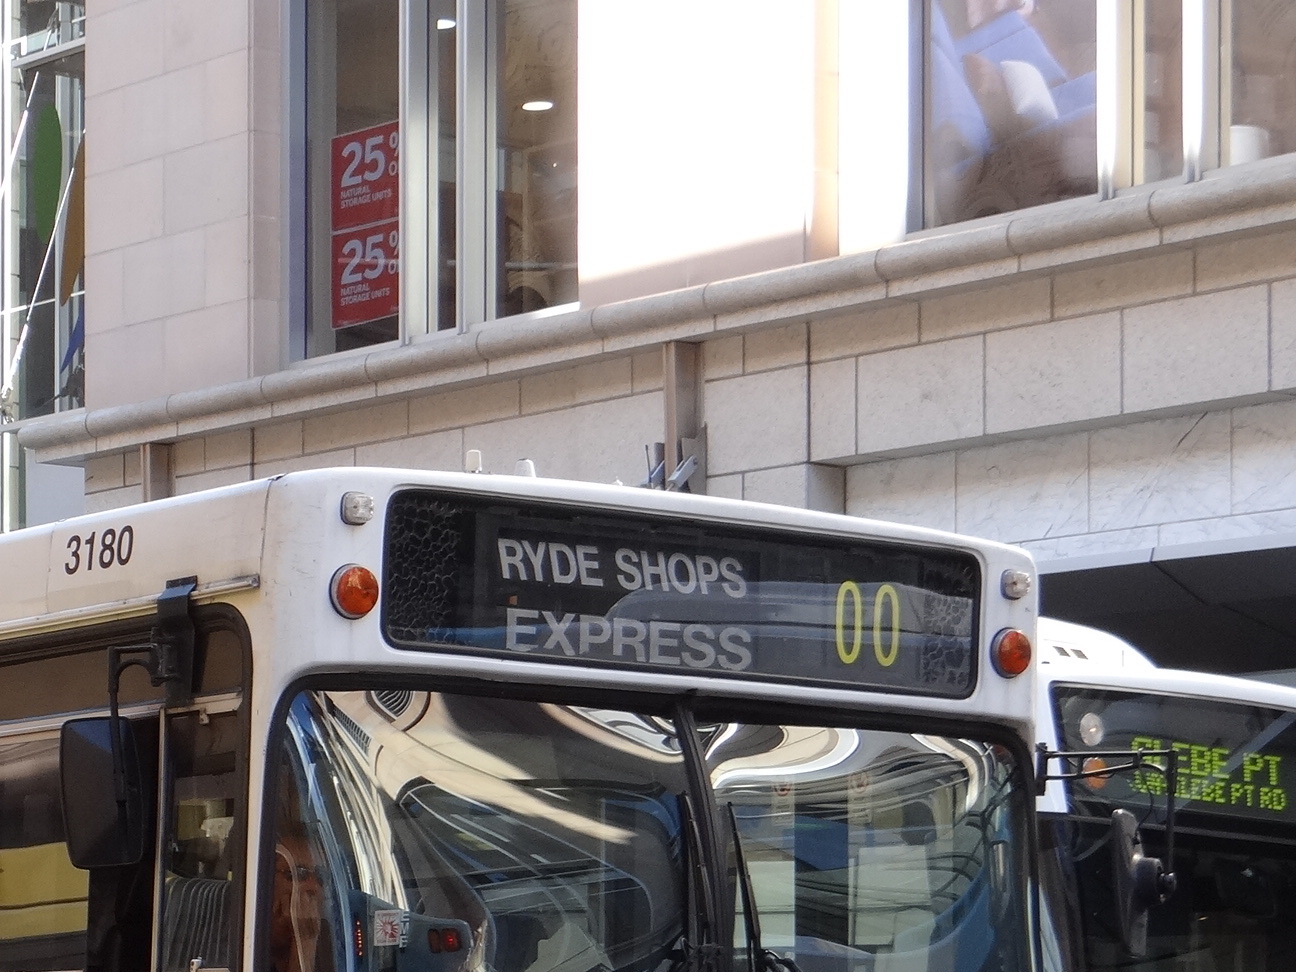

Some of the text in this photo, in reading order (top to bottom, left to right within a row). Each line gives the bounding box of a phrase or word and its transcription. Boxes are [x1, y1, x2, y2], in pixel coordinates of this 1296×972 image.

[64, 525, 134, 575] 3180
[497, 538, 747, 599] RYDE SHOPS
[505, 607, 752, 671] EXPRESS
[835, 580, 901, 668] 00
[1167, 775, 1226, 804] LEBE
[1243, 752, 1282, 786] PT
